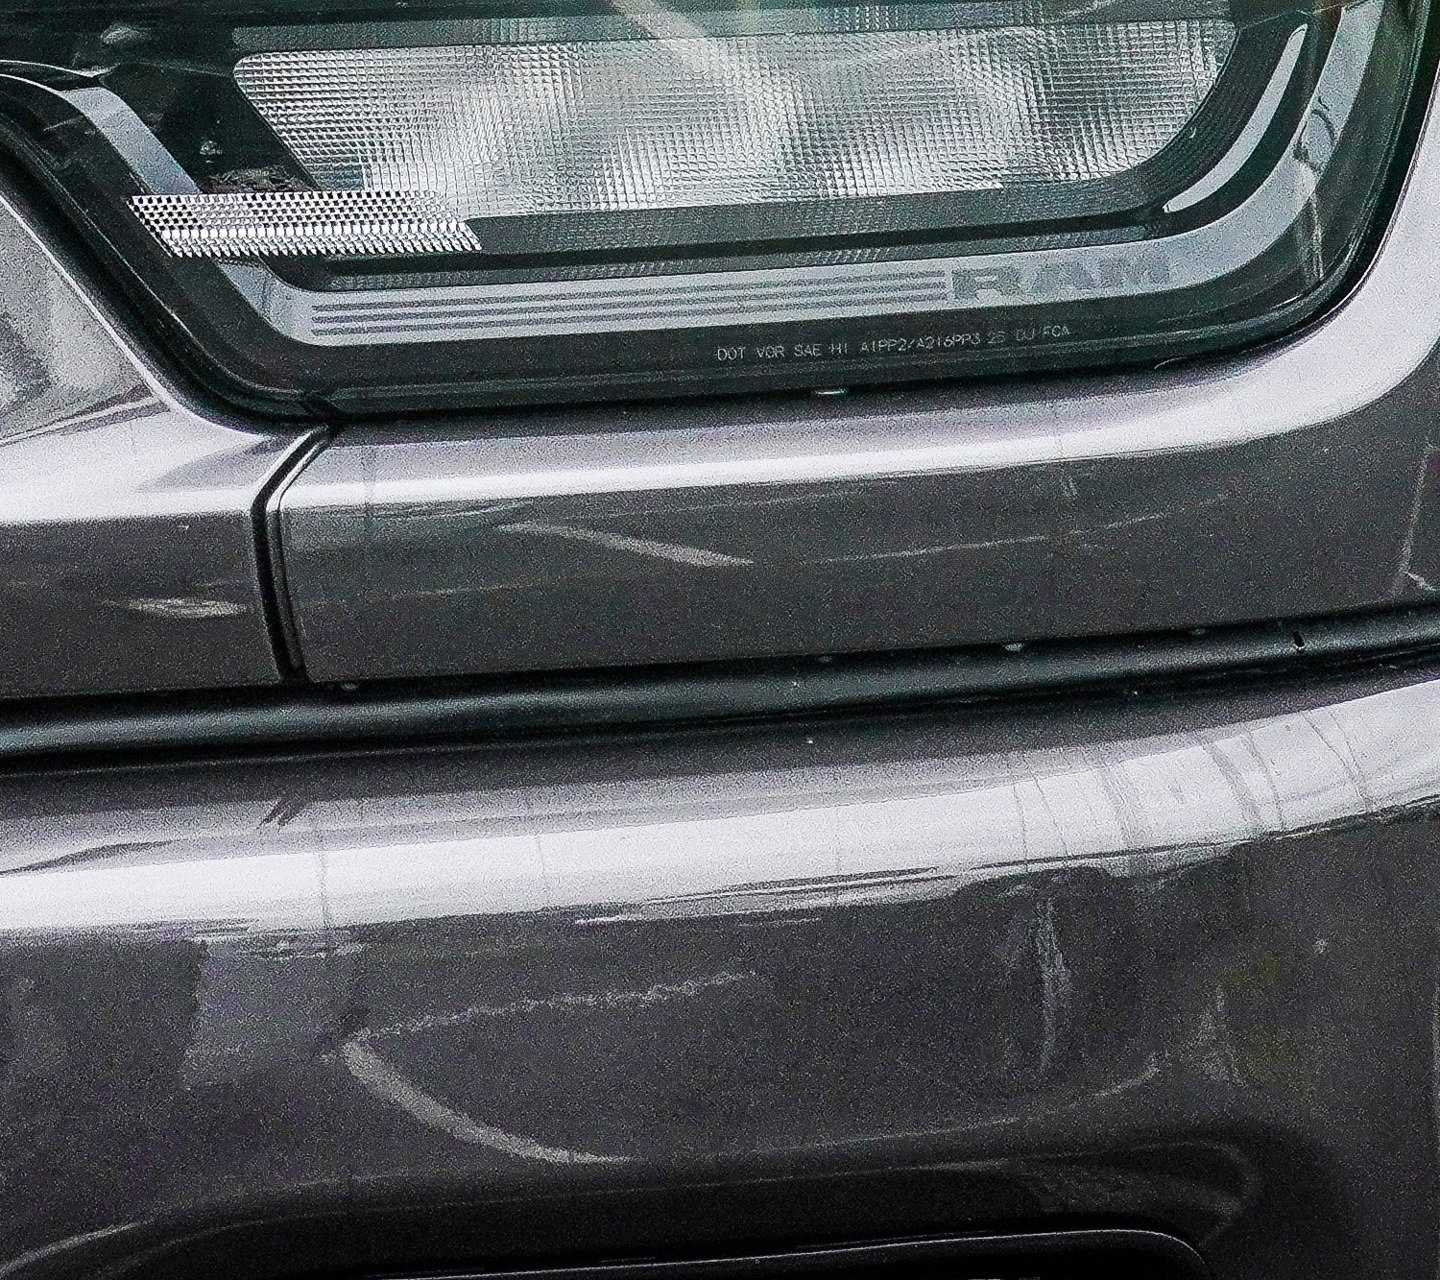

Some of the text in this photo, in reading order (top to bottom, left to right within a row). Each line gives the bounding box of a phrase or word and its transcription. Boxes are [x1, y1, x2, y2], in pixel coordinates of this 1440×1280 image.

[951, 258, 1171, 300] RAM
[717, 346, 746, 362] DOT
[794, 342, 823, 358] SAE
